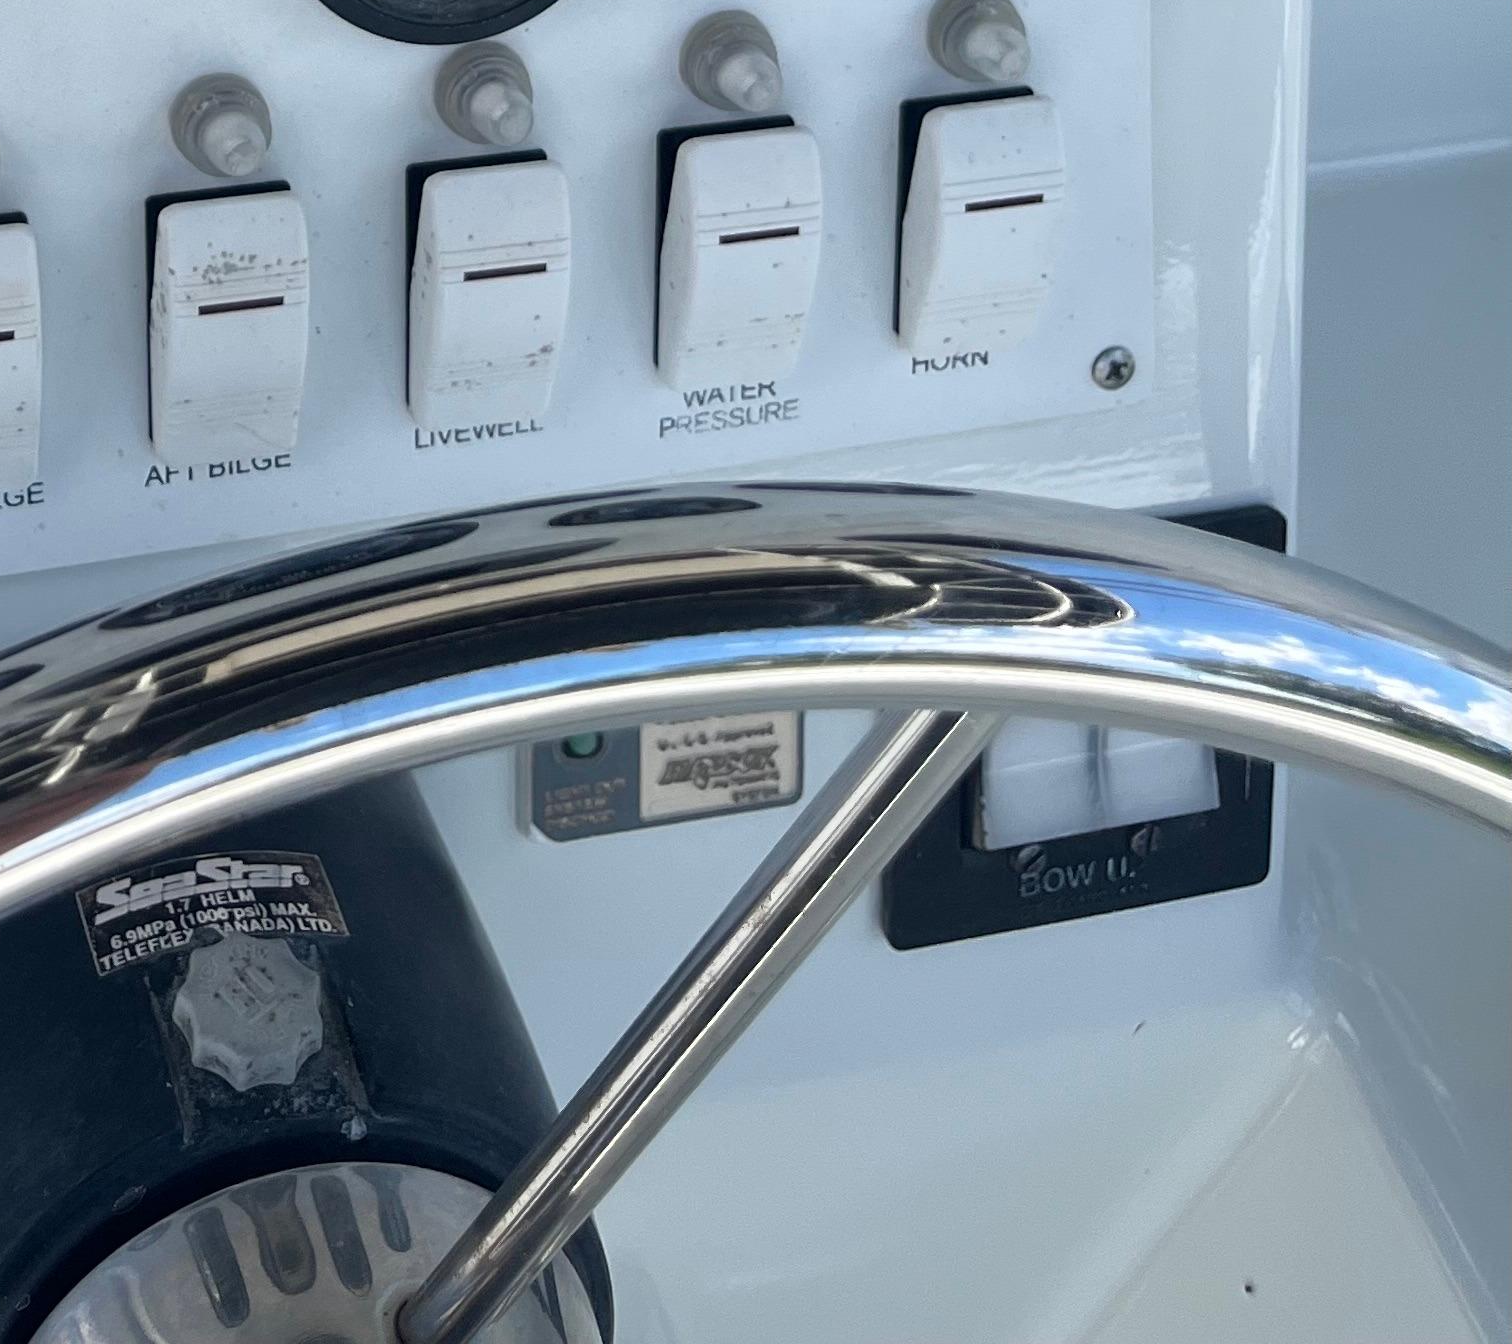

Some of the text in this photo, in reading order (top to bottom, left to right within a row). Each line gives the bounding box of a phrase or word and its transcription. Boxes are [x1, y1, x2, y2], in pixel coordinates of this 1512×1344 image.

[912, 350, 989, 375] HORN
[683, 380, 777, 409] WATER
[659, 398, 801, 440] PRESSURE
[414, 418, 544, 450] LIVEWELL
[208, 453, 292, 479] BILGE
[1019, 860, 1097, 899] BOW
[165, 888, 257, 914] 1.7 HELM
[109, 920, 177, 951] 6.9MPa
[233, 902, 268, 922] psi)
[269, 902, 318, 917] MAX.
[296, 916, 338, 933] LTD.
